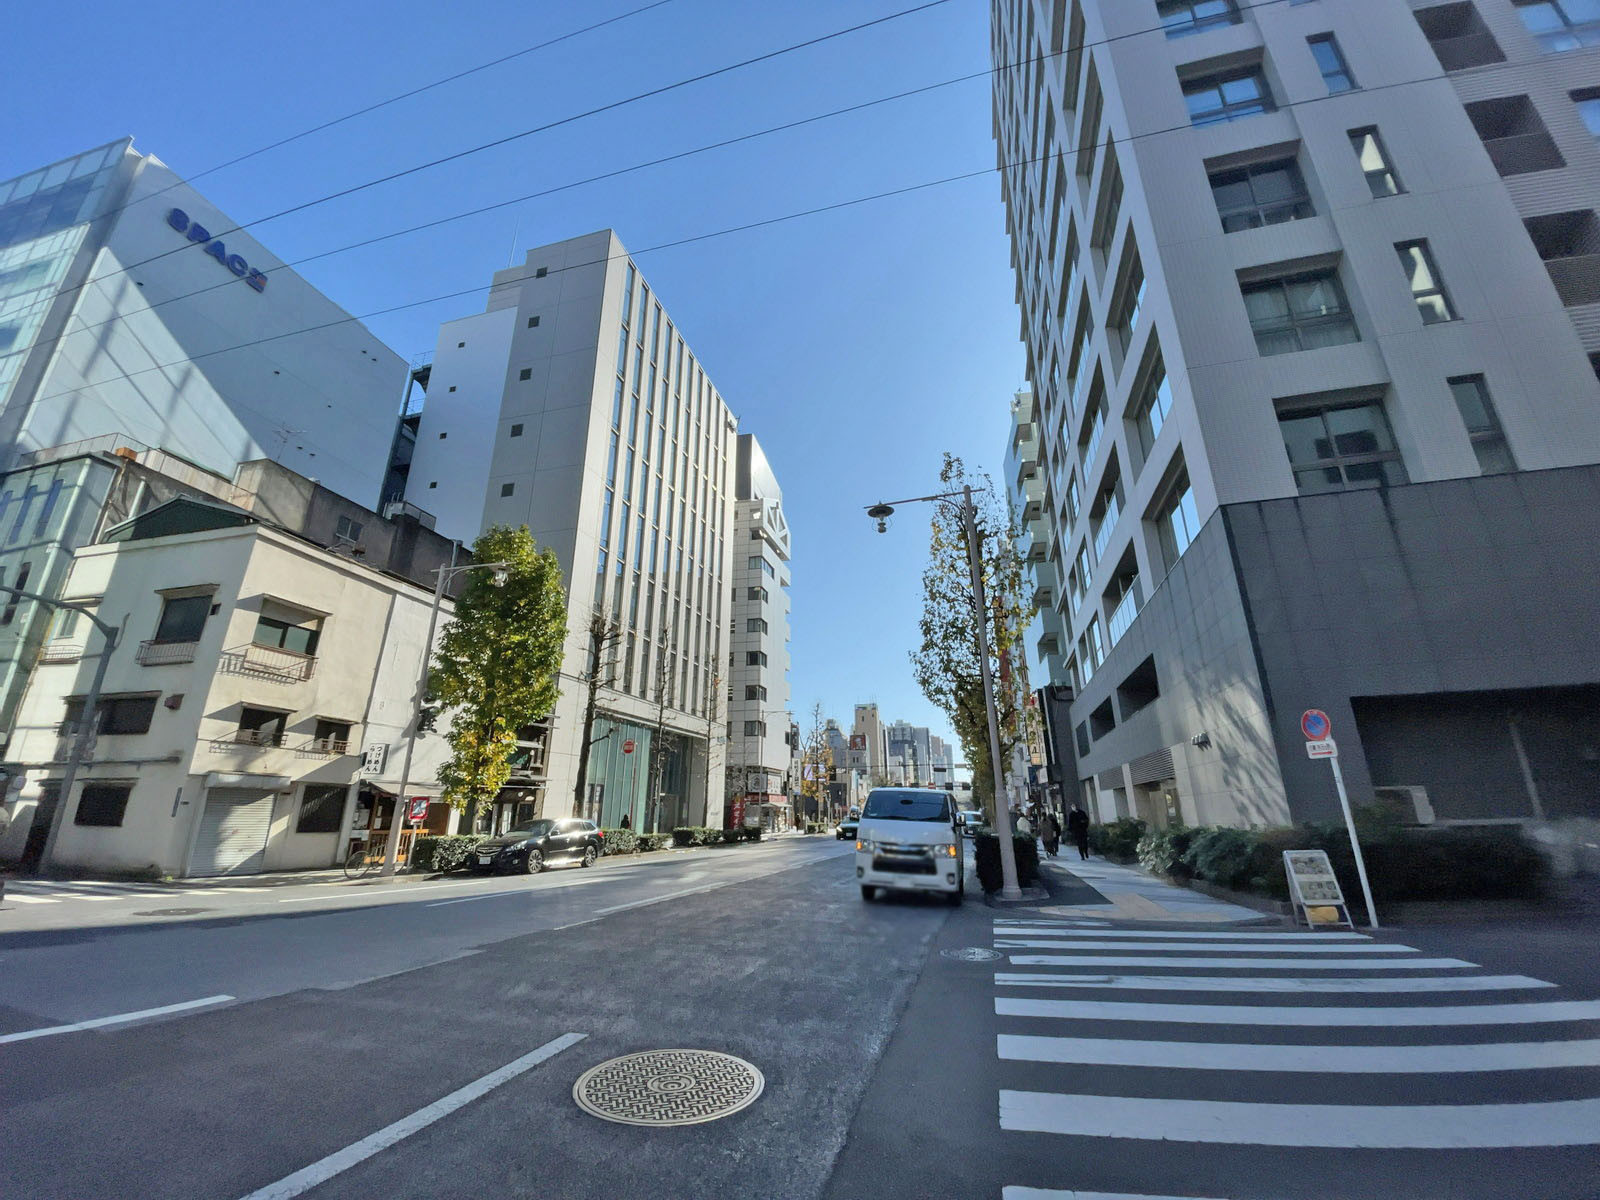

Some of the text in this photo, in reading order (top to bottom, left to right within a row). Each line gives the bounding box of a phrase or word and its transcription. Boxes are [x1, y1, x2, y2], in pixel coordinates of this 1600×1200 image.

[166, 207, 268, 294] SPACE
[365, 745, 375, 772] らーめん
[372, 746, 383, 772] つけめん
